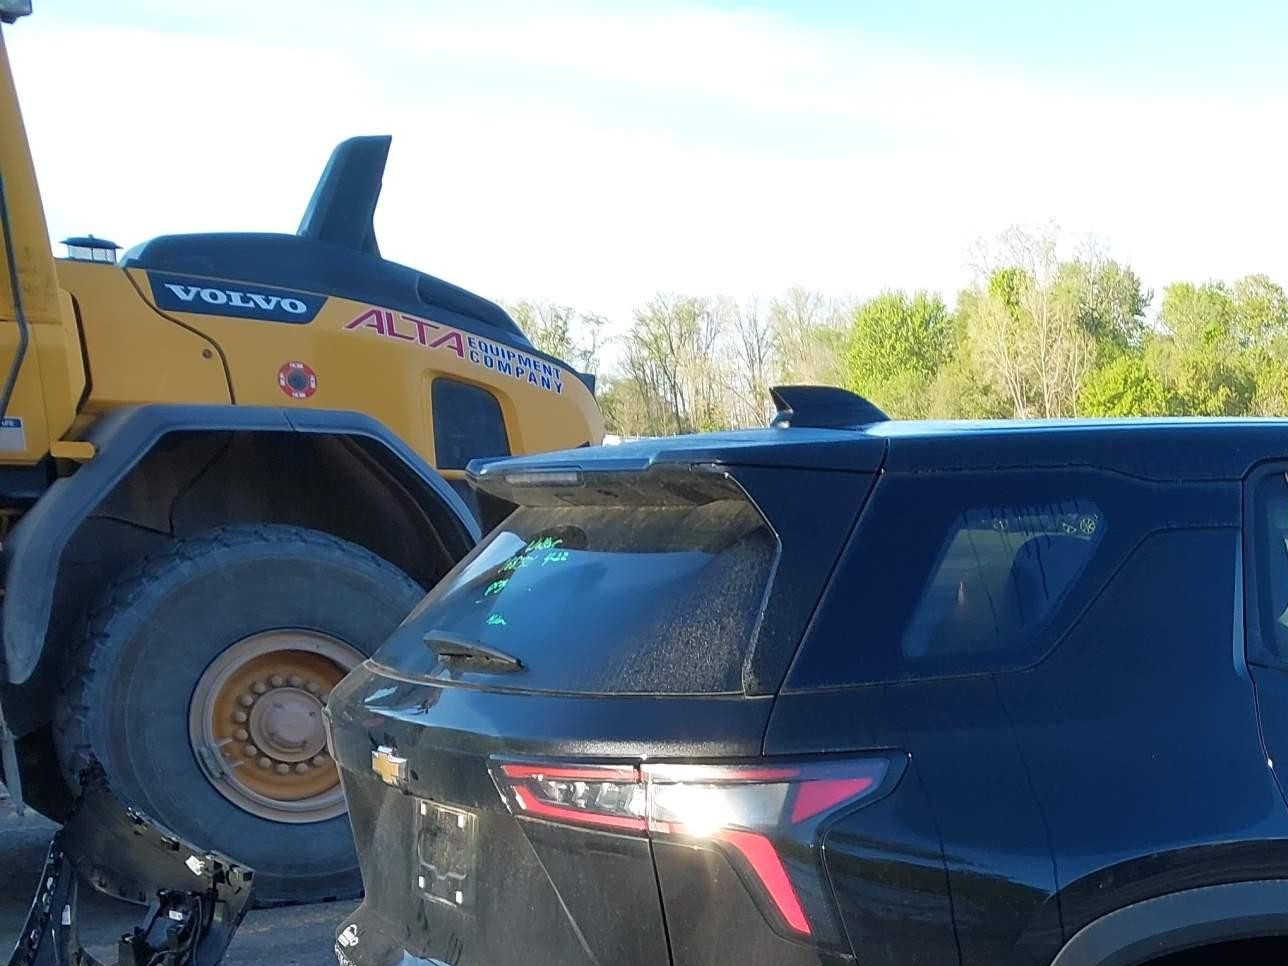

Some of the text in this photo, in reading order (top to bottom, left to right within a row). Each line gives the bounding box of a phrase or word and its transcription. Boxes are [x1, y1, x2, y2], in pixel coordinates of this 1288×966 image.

[164, 283, 307, 314] VOLVO
[344, 308, 465, 358] ALTA
[467, 335, 562, 380] EQUIPMENT
[469, 351, 563, 394] COMPANY
